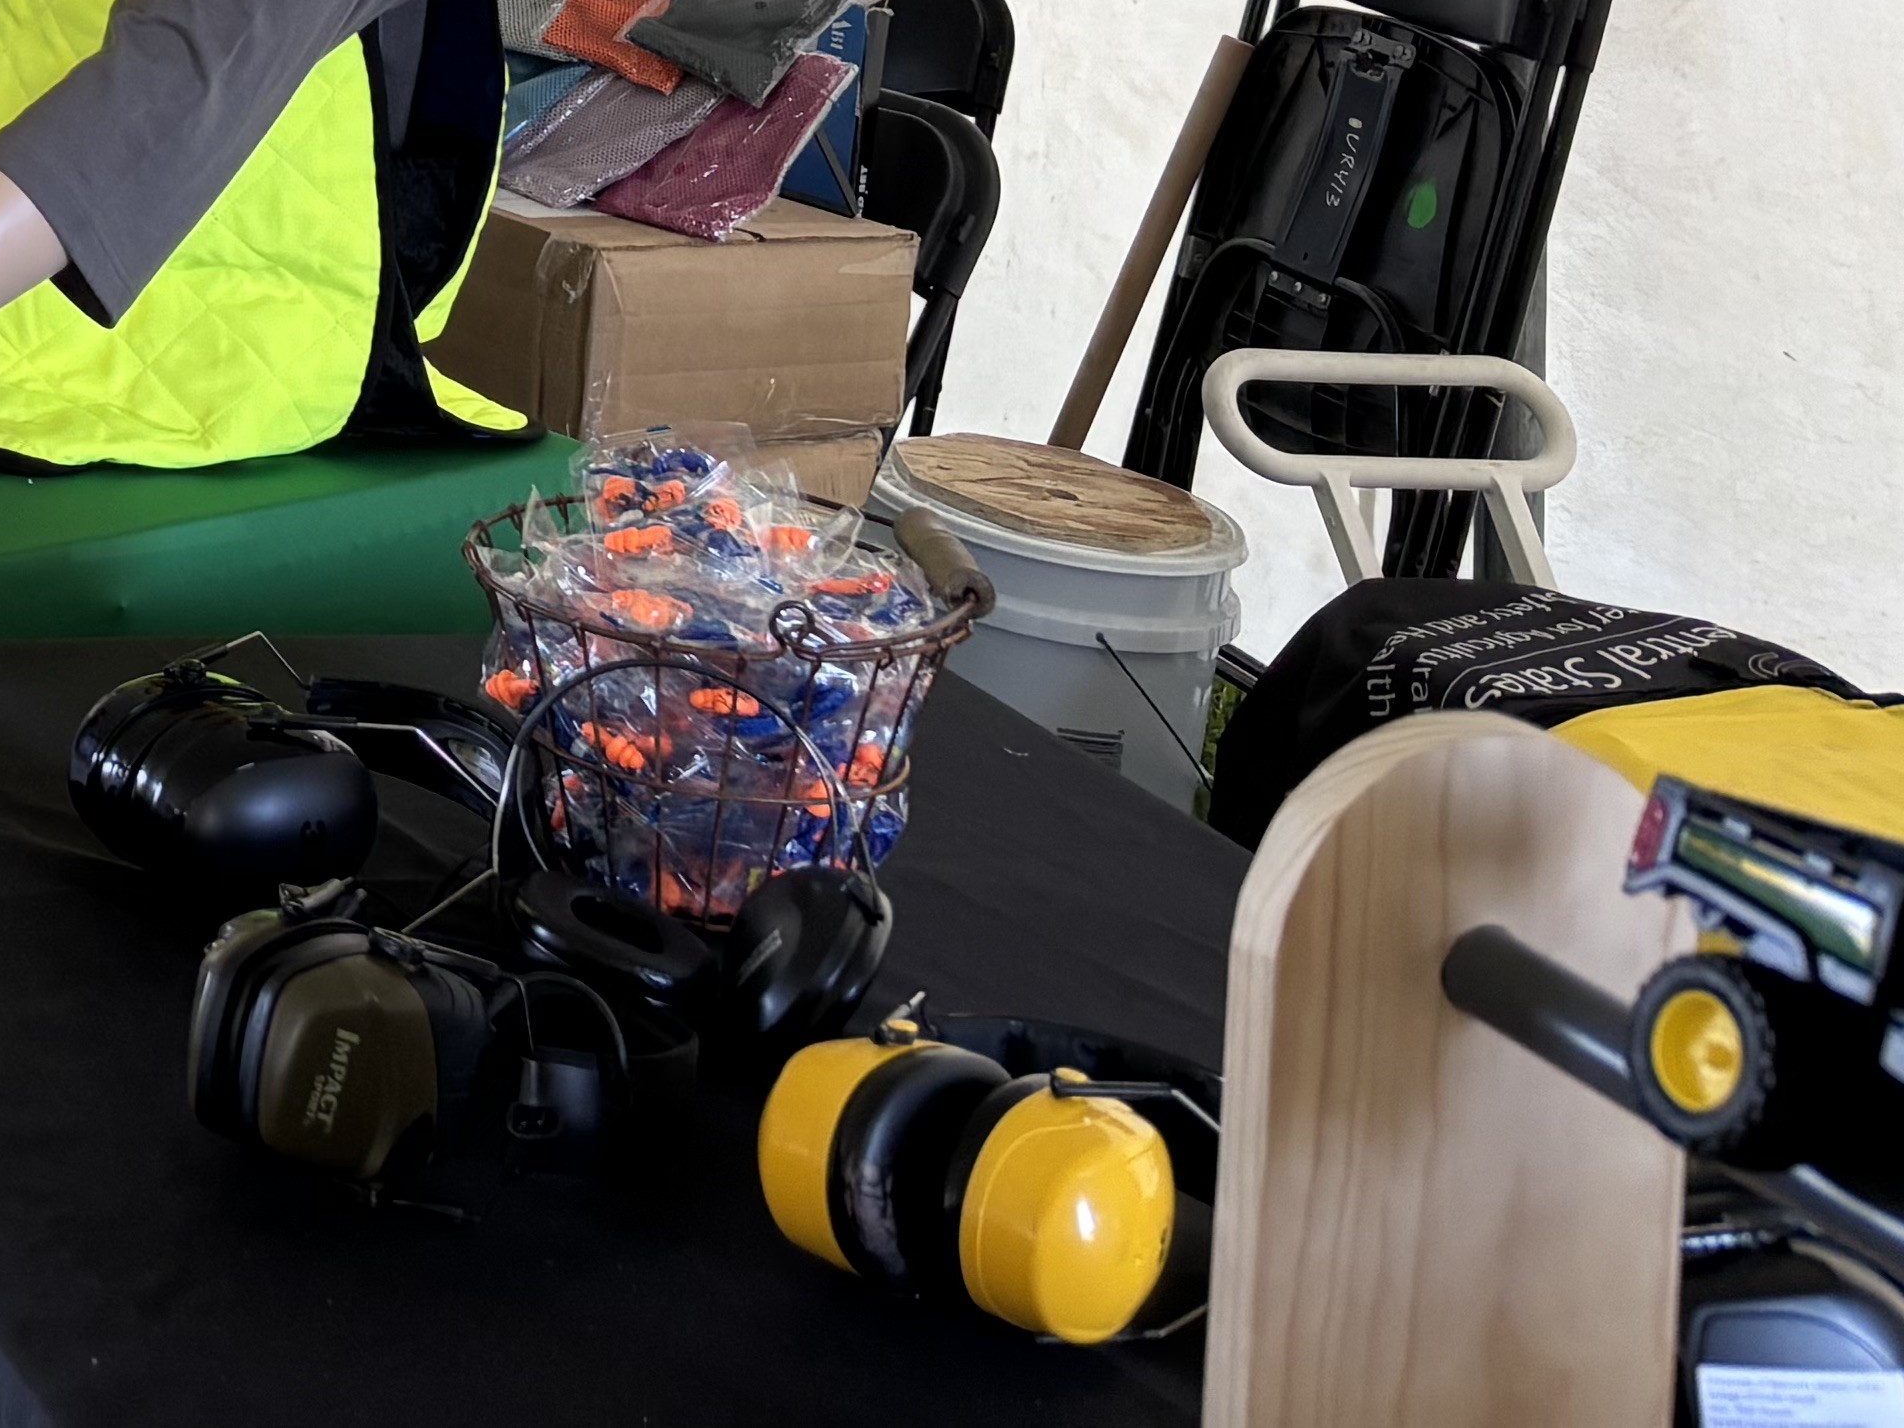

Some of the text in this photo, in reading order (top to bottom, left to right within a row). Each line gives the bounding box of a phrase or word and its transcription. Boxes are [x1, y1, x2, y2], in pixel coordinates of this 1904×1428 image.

[1433, 613, 1487, 636] and
[1465, 624, 1739, 710] entral States
[1367, 623, 1436, 718] Health
[317, 1027, 360, 1131] IMPACT
